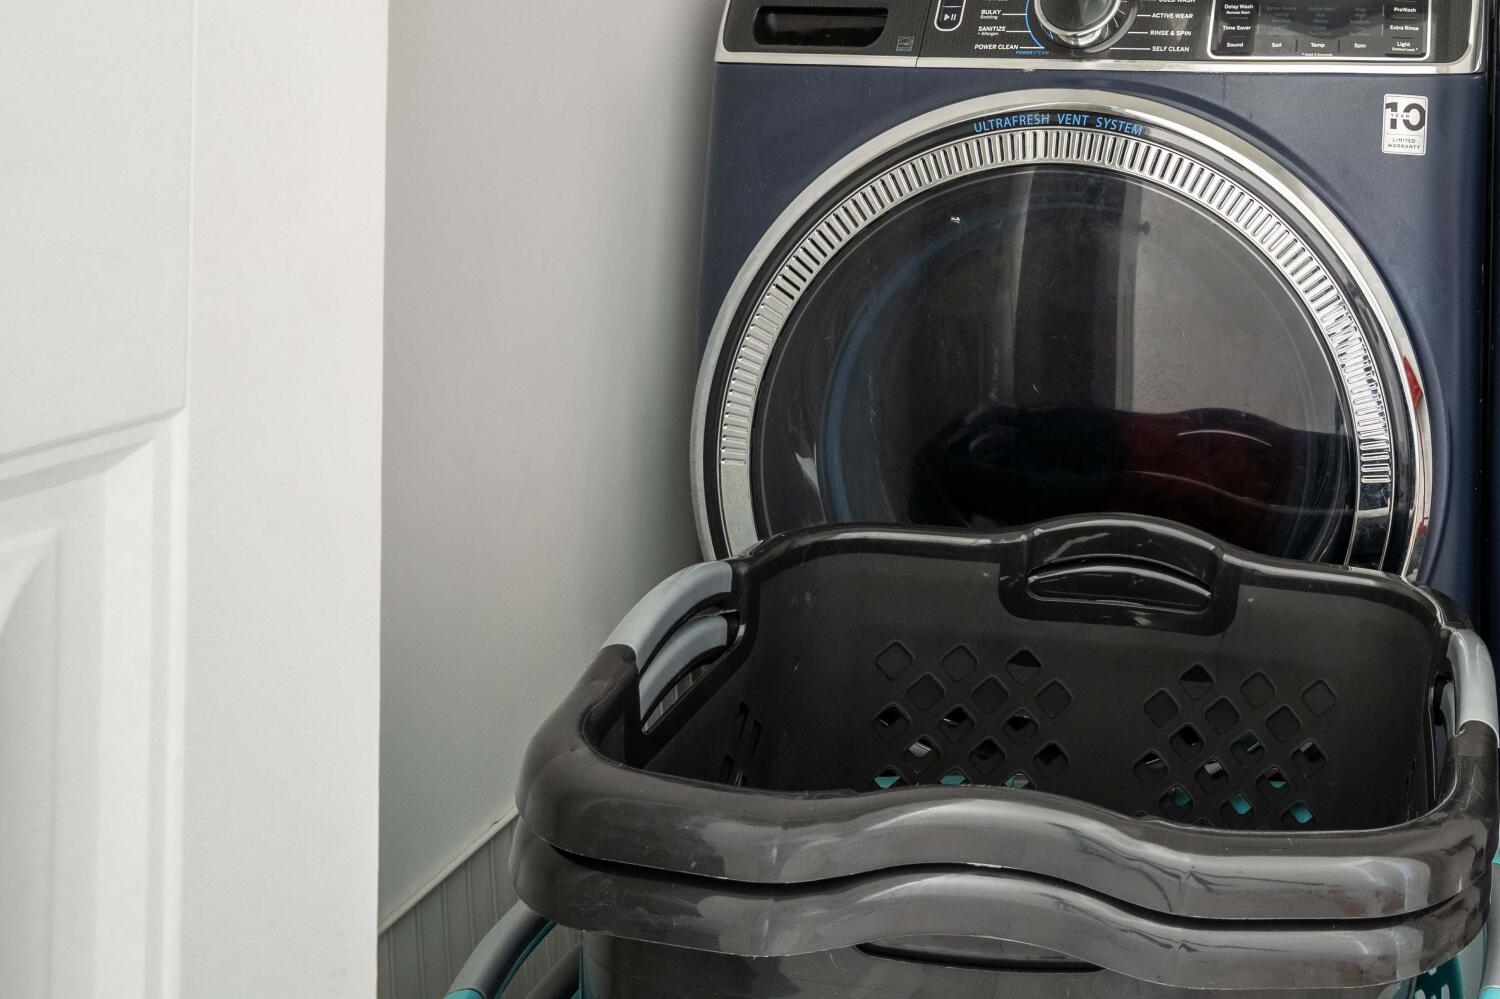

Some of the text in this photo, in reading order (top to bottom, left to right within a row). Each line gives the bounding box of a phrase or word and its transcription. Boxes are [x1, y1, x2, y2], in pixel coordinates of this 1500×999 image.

[973, 113, 1143, 136] ULTRAFRESH VENT SYSTEM
[1385, 102, 1426, 131] 10
